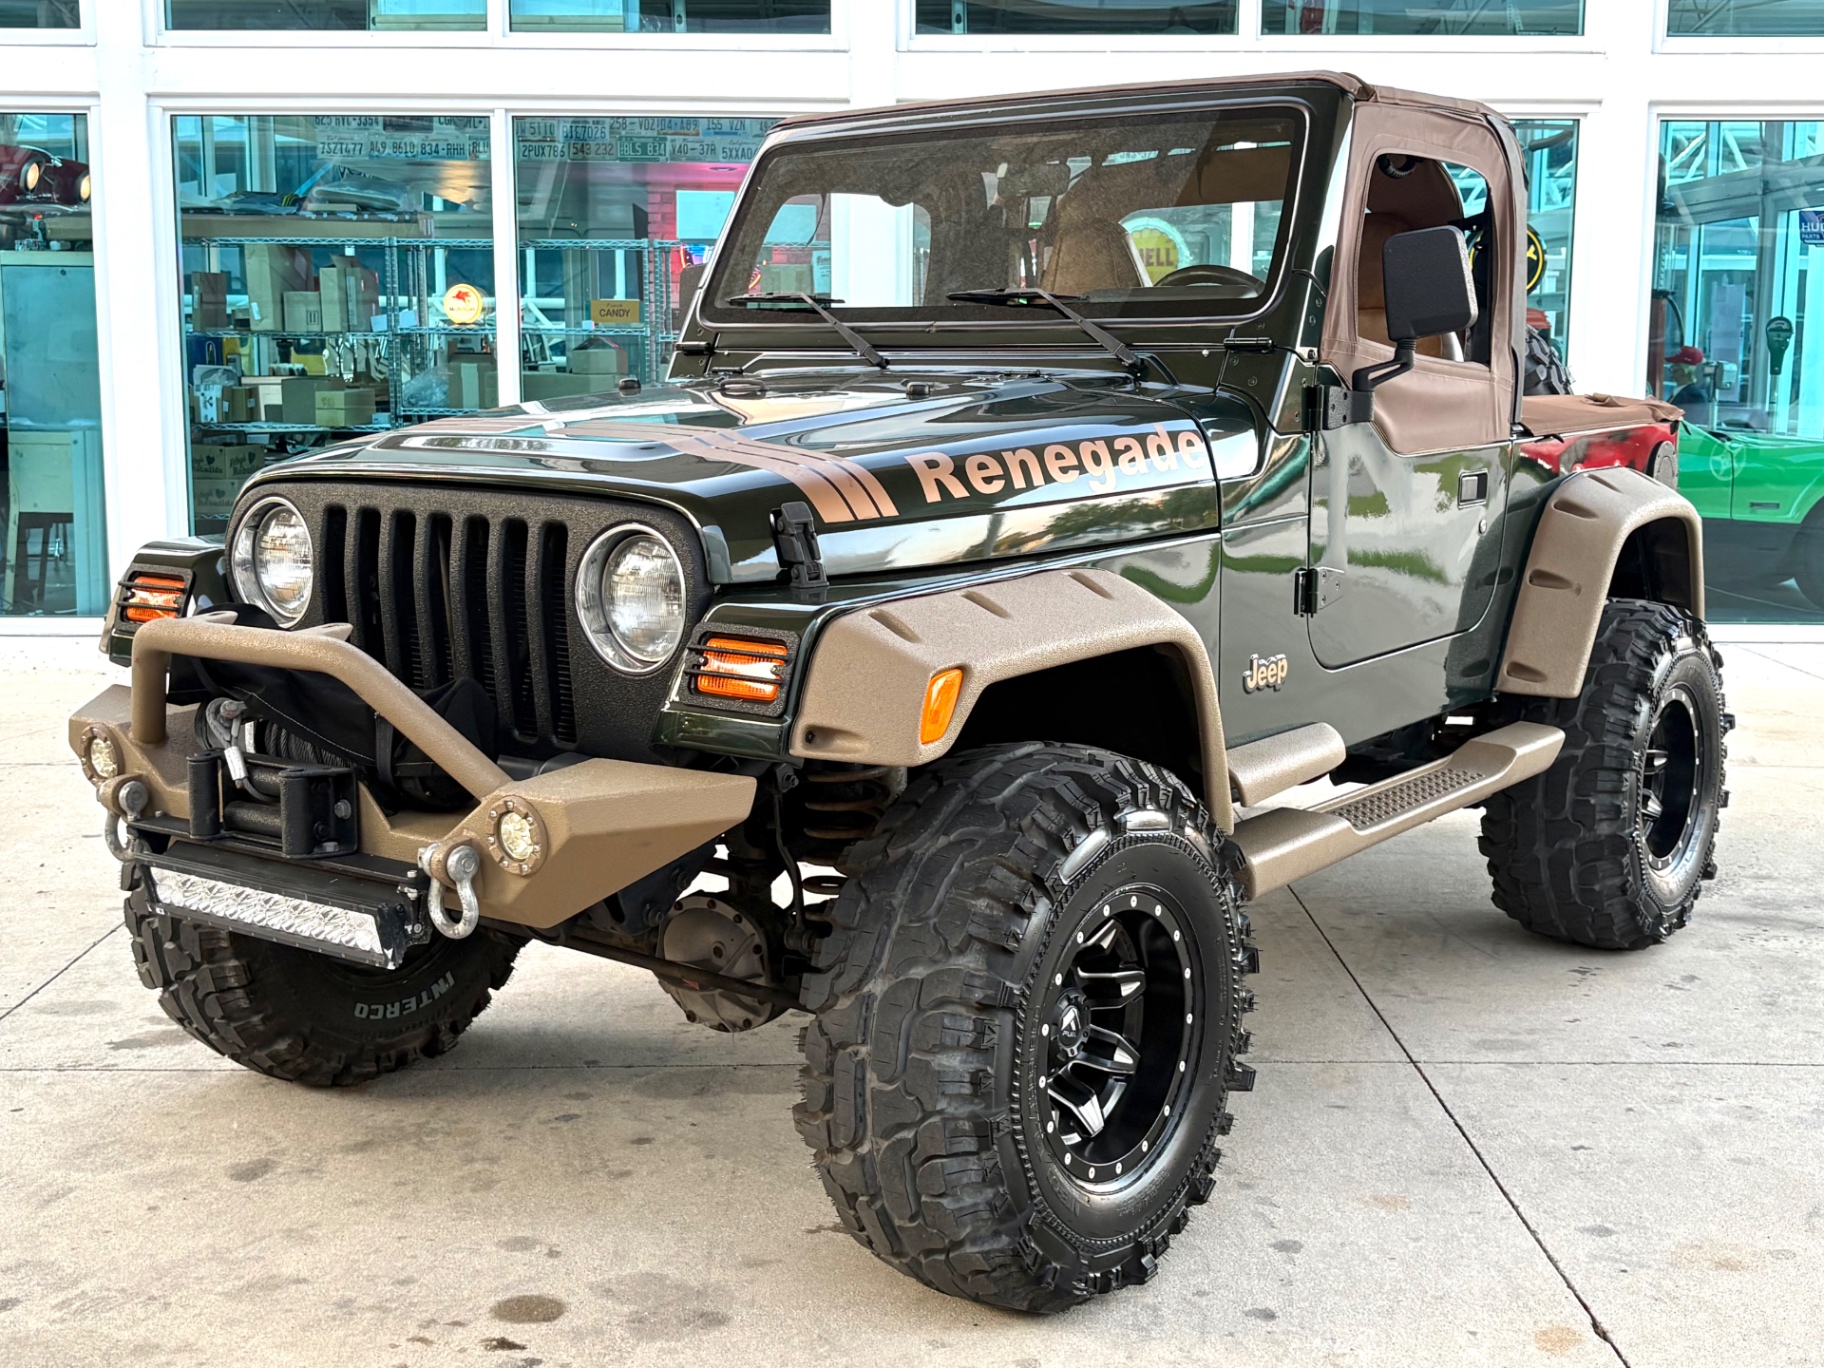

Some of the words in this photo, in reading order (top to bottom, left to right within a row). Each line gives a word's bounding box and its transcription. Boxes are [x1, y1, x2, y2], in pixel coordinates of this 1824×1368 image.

[599, 308, 630, 318] CANDY
[904, 423, 1207, 504] Renegade
[1243, 653, 1288, 694] Jeep
[354, 970, 455, 1019] INTERCO
